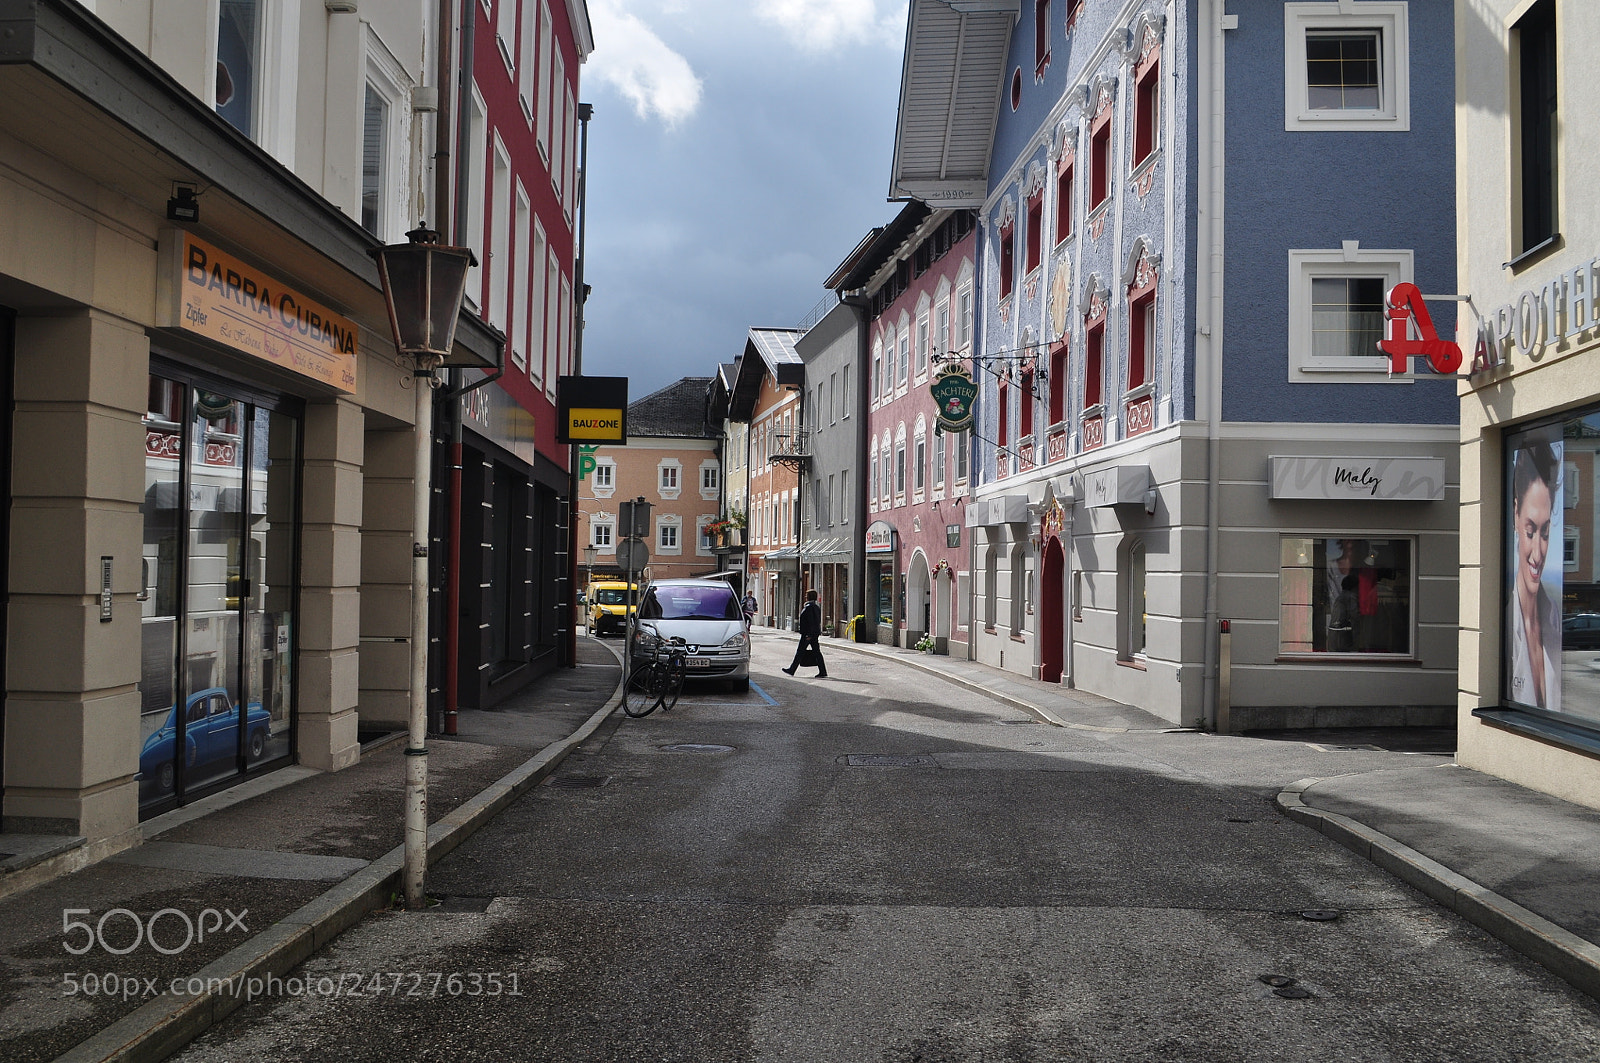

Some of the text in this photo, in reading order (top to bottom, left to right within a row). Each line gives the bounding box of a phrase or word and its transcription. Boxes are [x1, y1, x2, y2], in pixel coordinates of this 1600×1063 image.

[186, 303, 208, 326] Zipfer
[188, 244, 356, 358] BARRA CUBANA
[1471, 255, 1600, 374] APOTH
[342, 370, 355, 387] Zipfer
[461, 375, 489, 428] UZONE
[573, 419, 619, 428] BAUZONE
[1335, 466, 1383, 496] Maly
